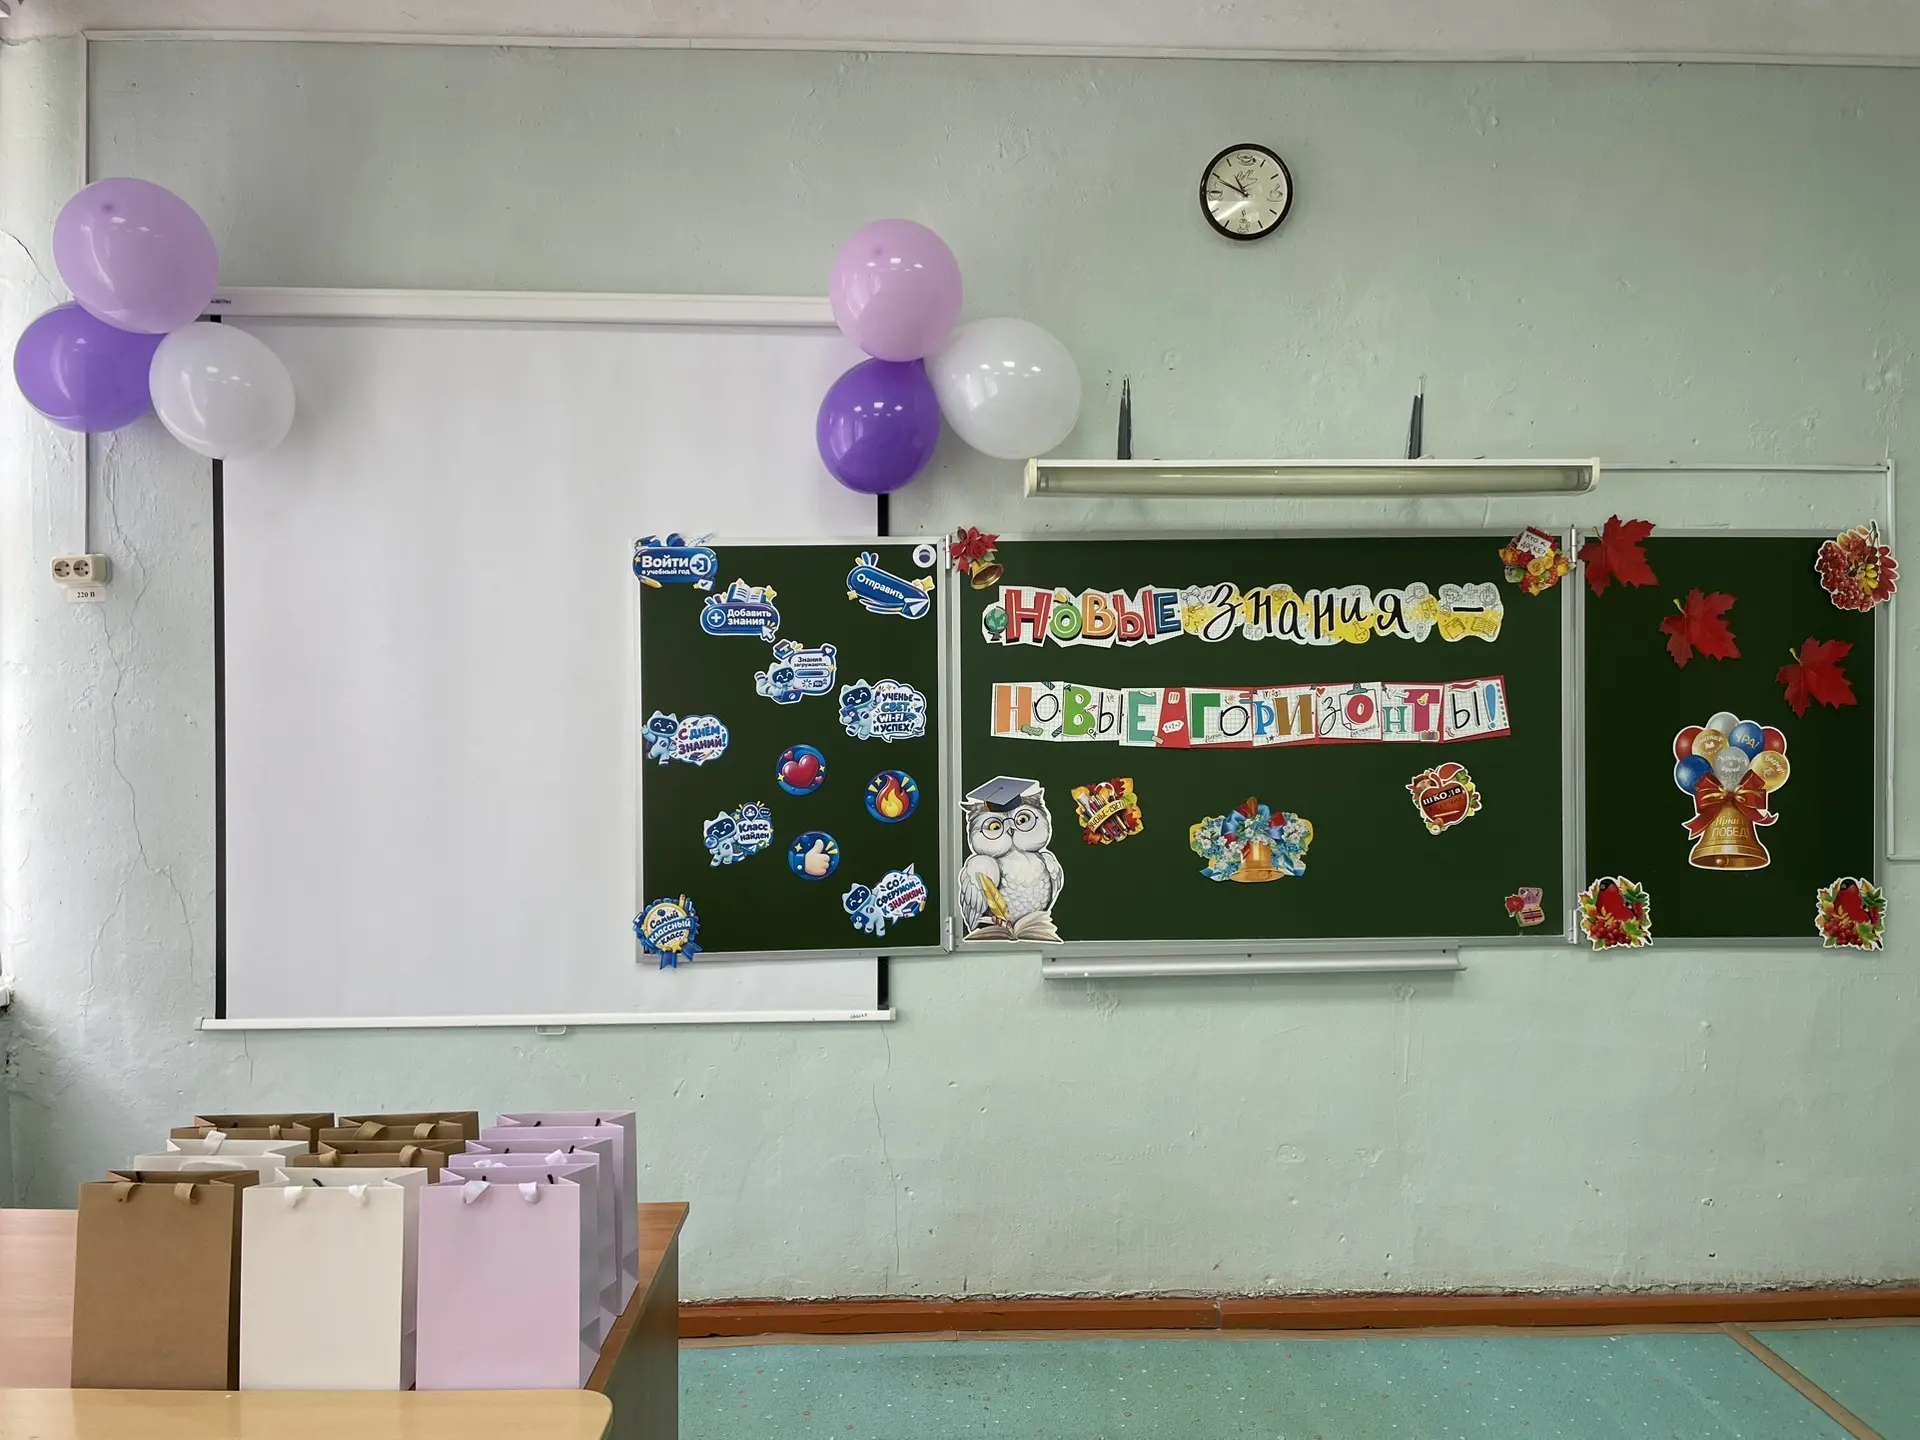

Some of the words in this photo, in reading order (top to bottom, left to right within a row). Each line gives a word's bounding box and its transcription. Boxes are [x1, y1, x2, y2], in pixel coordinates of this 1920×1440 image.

[641, 554, 689, 568] Войти
[646, 568, 677, 576] учебный
[856, 573, 905, 599] Отправить
[726, 608, 772, 618] Добавить
[1004, 588, 1182, 644] НОВЫЕ
[727, 618, 765, 626] знания
[878, 713, 904, 723] WI-FI
[994, 683, 1158, 742] НОВЫЕ
[1190, 683, 1497, 740] ГОРИЗОНТЫ!
[677, 727, 688, 740] С
[880, 722, 915, 733] УСПЕХ!
[678, 732, 728, 755] ЗНАНИЙ!
[1735, 732, 1760, 749] УРА!
[738, 822, 769, 833] Класс
[739, 831, 770, 842] найден
[885, 879, 900, 891] СО
[887, 886, 925, 912] ЗНАНИЯМ!
[649, 909, 680, 930] Самый
